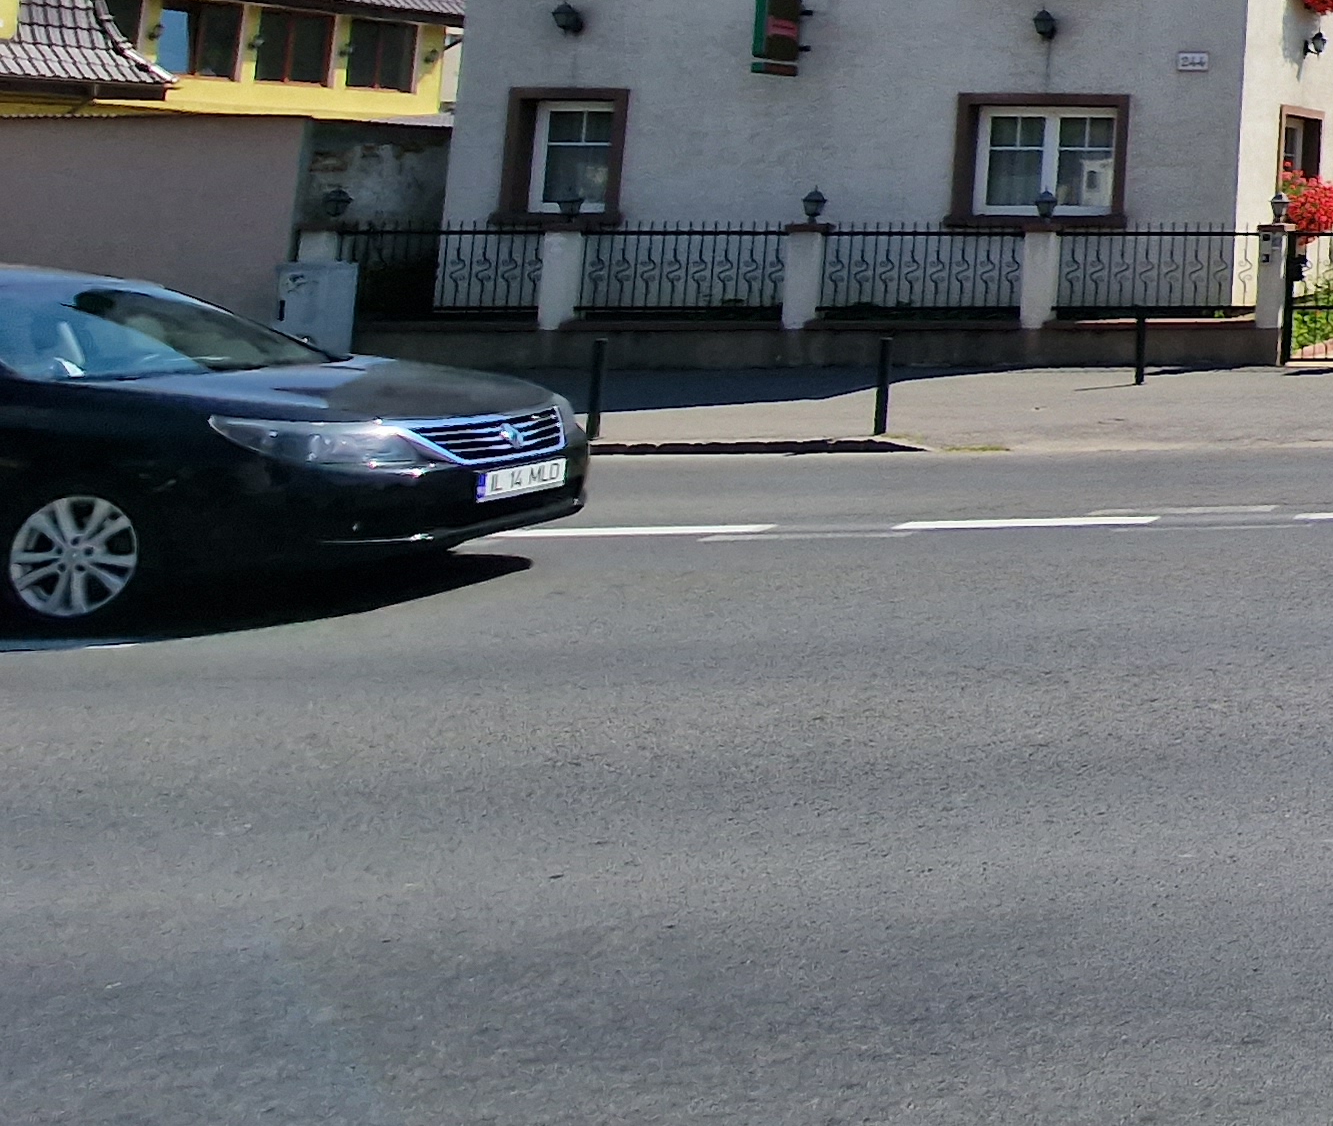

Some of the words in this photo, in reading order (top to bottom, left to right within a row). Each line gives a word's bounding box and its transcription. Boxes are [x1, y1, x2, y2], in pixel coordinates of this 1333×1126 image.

[490, 473, 503, 492] IL
[511, 469, 522, 489] 14
[529, 462, 561, 485] MLD
